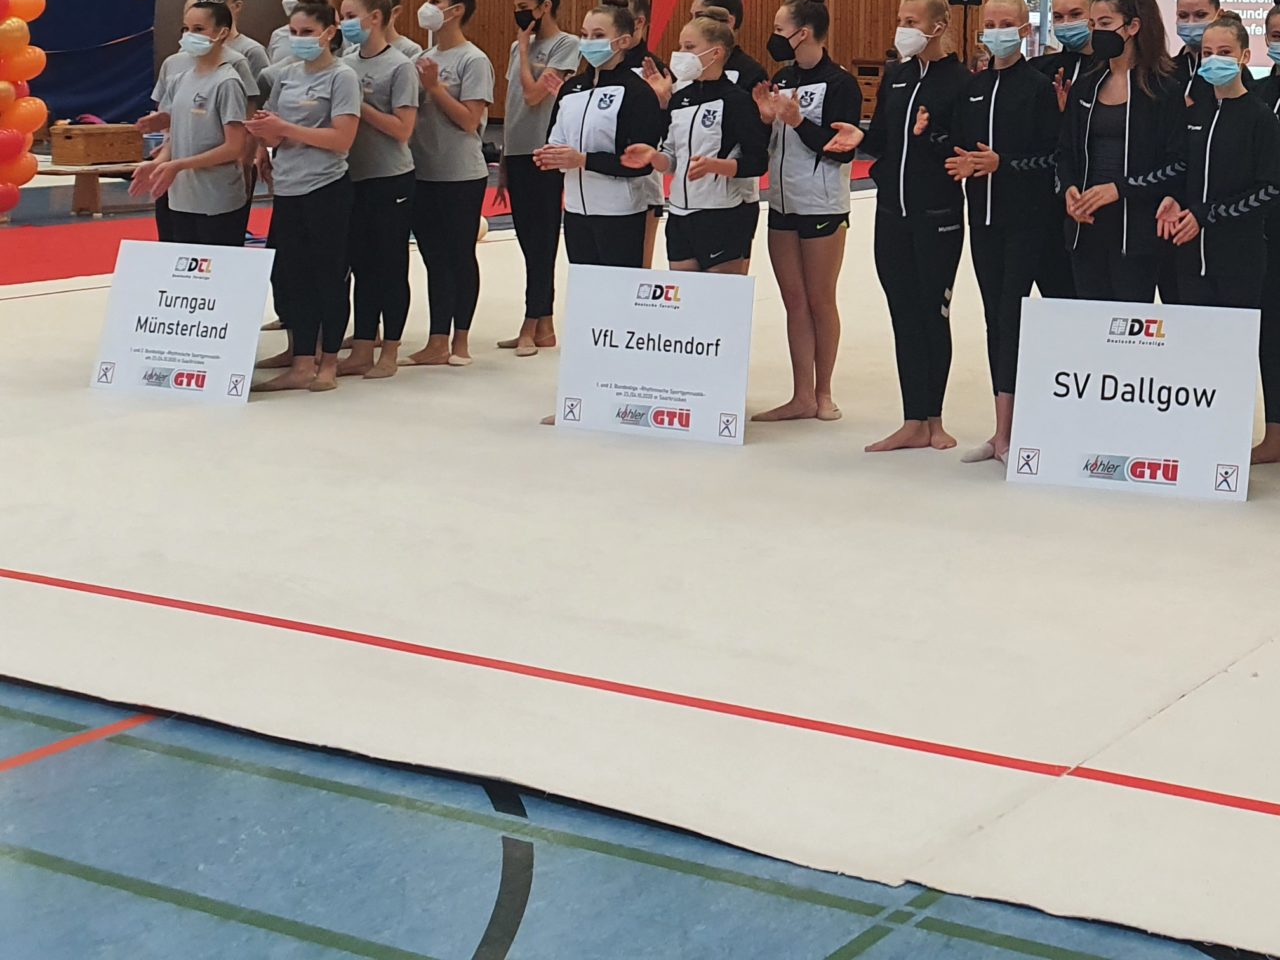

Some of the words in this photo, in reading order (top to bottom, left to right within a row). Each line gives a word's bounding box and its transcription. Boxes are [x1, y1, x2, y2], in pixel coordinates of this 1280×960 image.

[187, 257, 212, 273] DTL
[158, 290, 216, 314] Turngau
[651, 284, 681, 302] DTL
[135, 316, 228, 340] Münsterland
[1128, 318, 1166, 338] DTL
[592, 328, 619, 348] VfL
[625, 331, 721, 357] Zehlendorf
[173, 370, 207, 389] GTÜ
[1053, 371, 1091, 399] SV
[1101, 375, 1216, 412] Dallgow
[652, 408, 691, 428] GTÜ
[1130, 459, 1179, 482] GTÜ
